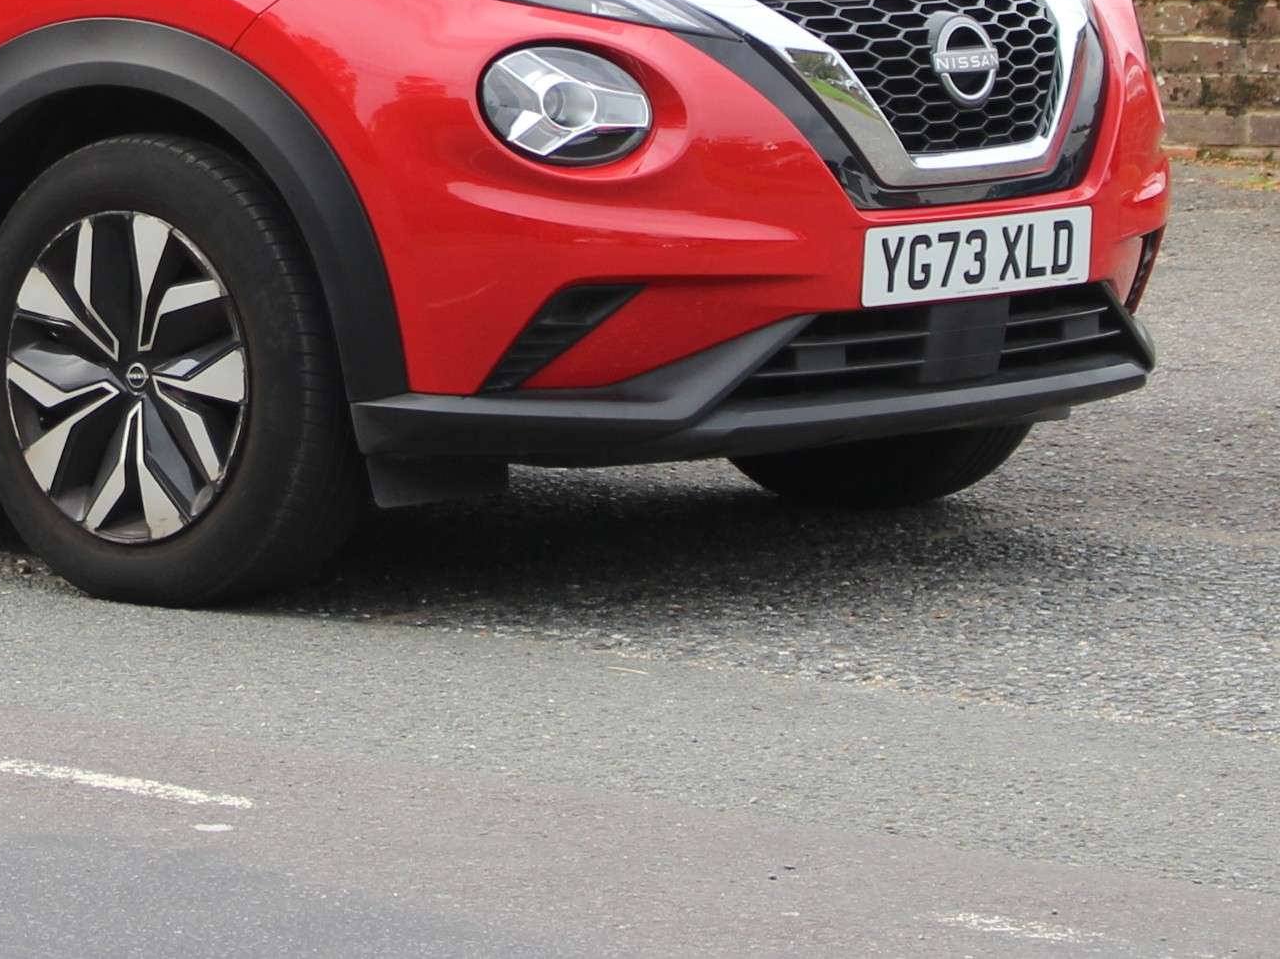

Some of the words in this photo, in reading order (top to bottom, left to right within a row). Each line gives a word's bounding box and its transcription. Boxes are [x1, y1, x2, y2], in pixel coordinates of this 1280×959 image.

[936, 53, 999, 69] NISSAN
[881, 229, 987, 293] YG73
[999, 220, 1073, 282] XLD
